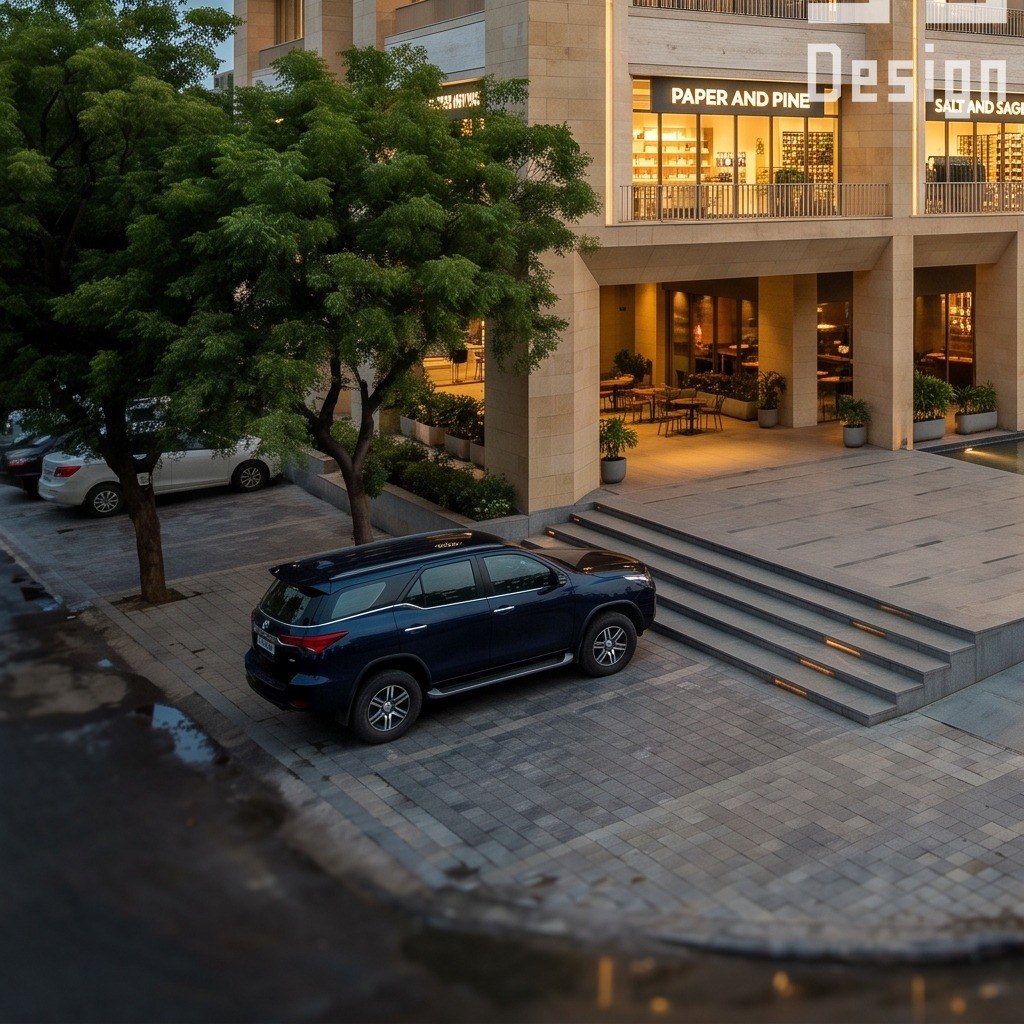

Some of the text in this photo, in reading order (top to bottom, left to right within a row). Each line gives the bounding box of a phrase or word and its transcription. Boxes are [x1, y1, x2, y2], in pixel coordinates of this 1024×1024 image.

[671, 87, 810, 109] PAPER AND PINE
[934, 98, 965, 113] SALT
[966, 99, 994, 115] AND
